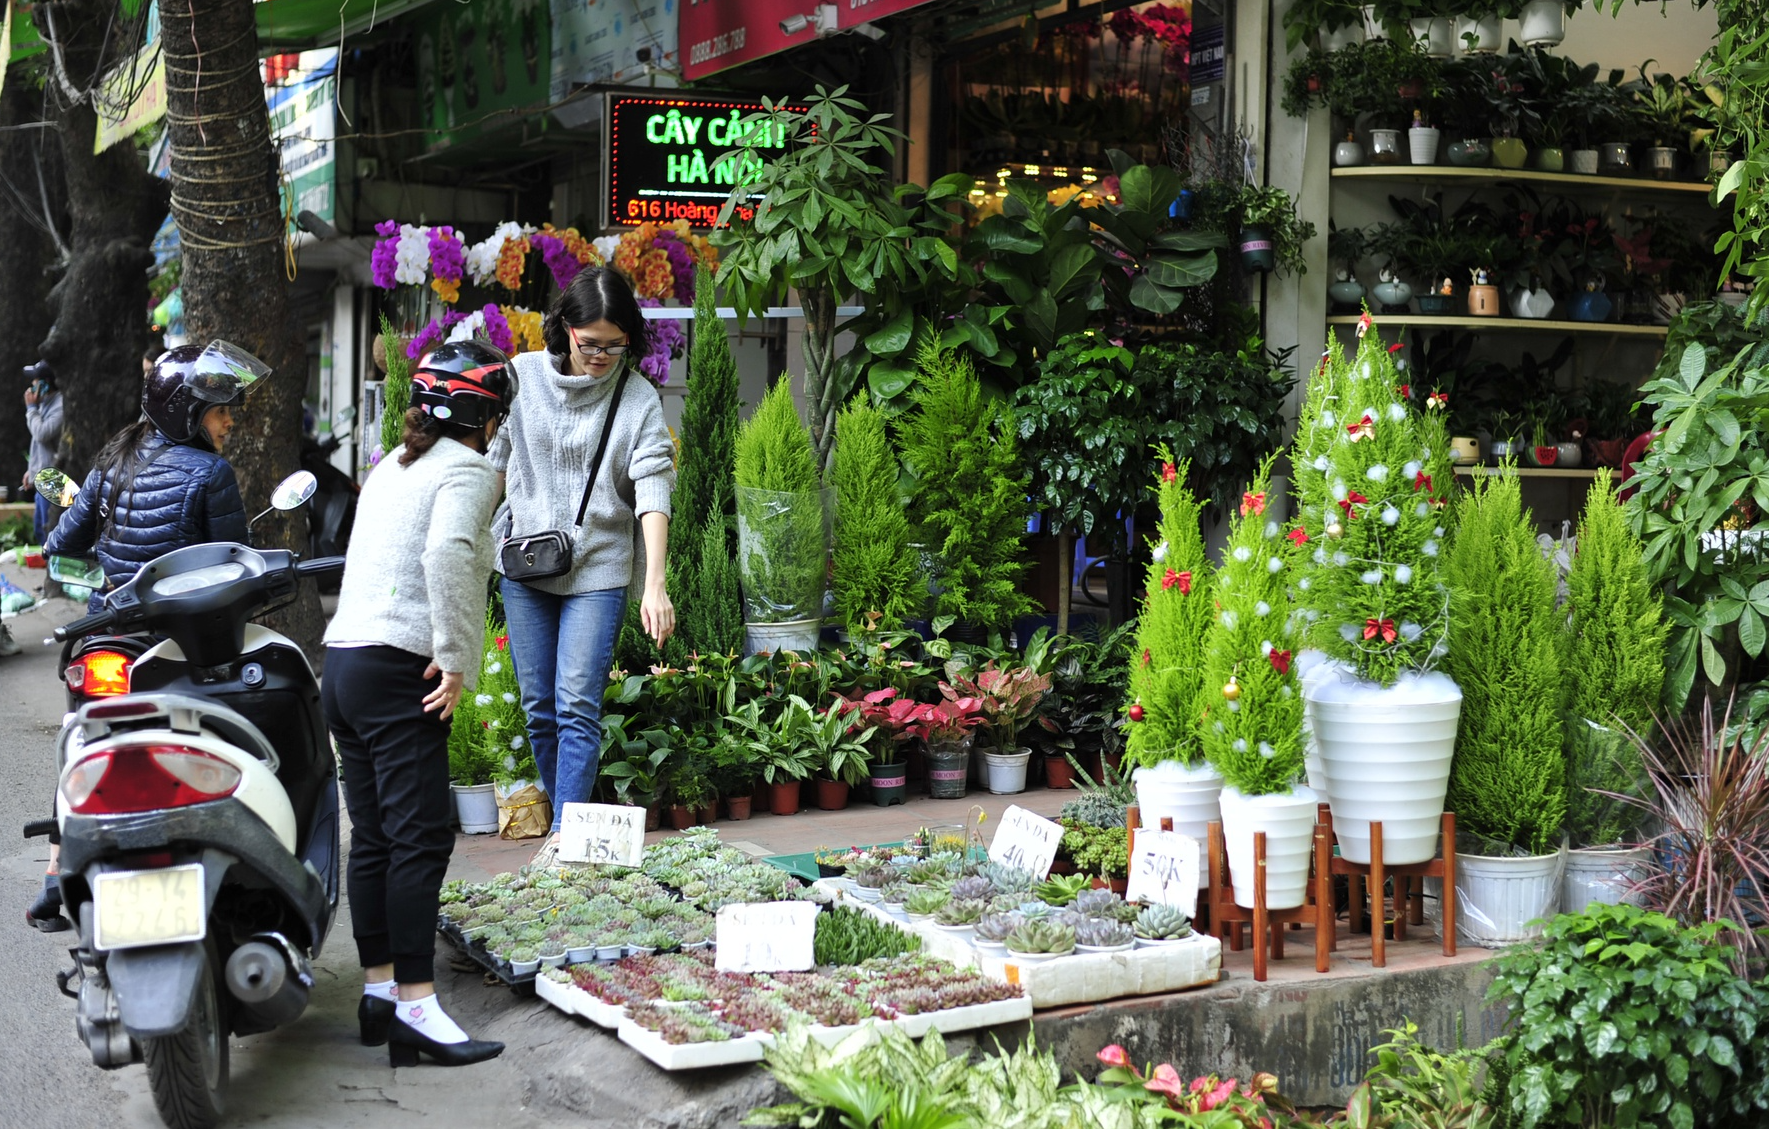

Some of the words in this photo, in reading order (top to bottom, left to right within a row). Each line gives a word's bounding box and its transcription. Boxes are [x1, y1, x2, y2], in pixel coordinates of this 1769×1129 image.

[646, 109, 703, 145] CÂY
[667, 148, 709, 184] HÀ
[627, 199, 662, 218] 616
[664, 200, 718, 222] Hoàng
